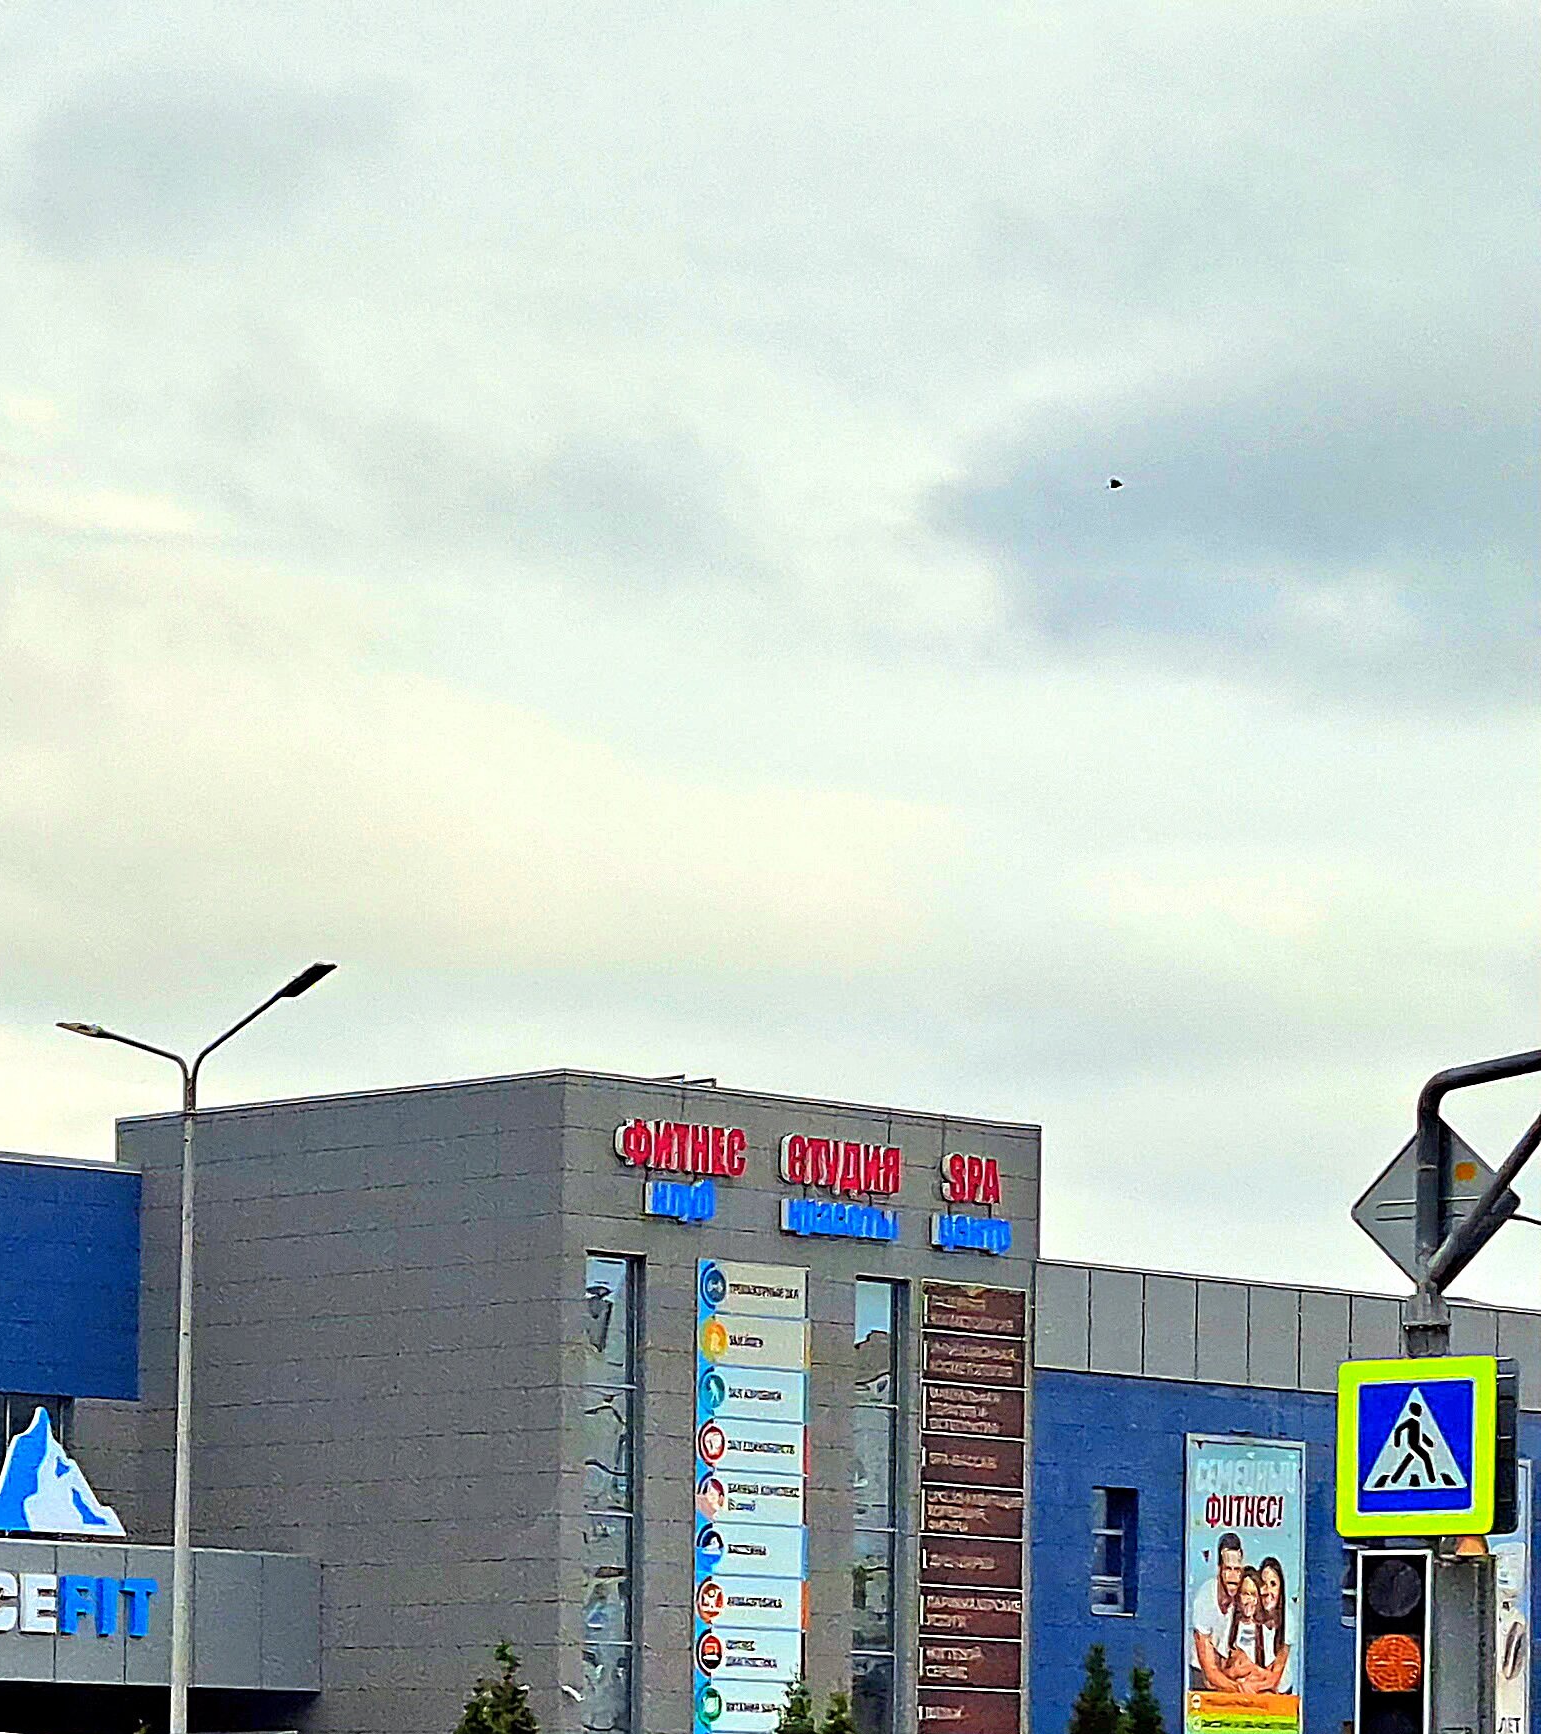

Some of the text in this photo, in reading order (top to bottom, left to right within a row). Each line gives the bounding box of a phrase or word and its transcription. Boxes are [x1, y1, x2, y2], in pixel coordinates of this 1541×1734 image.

[616, 1117, 748, 1177] ФИТНЕС
[779, 1132, 902, 1197] СТУДИЯ
[941, 1151, 1002, 1205] SPA
[1205, 1493, 1284, 1529] ФИТНЕС!
